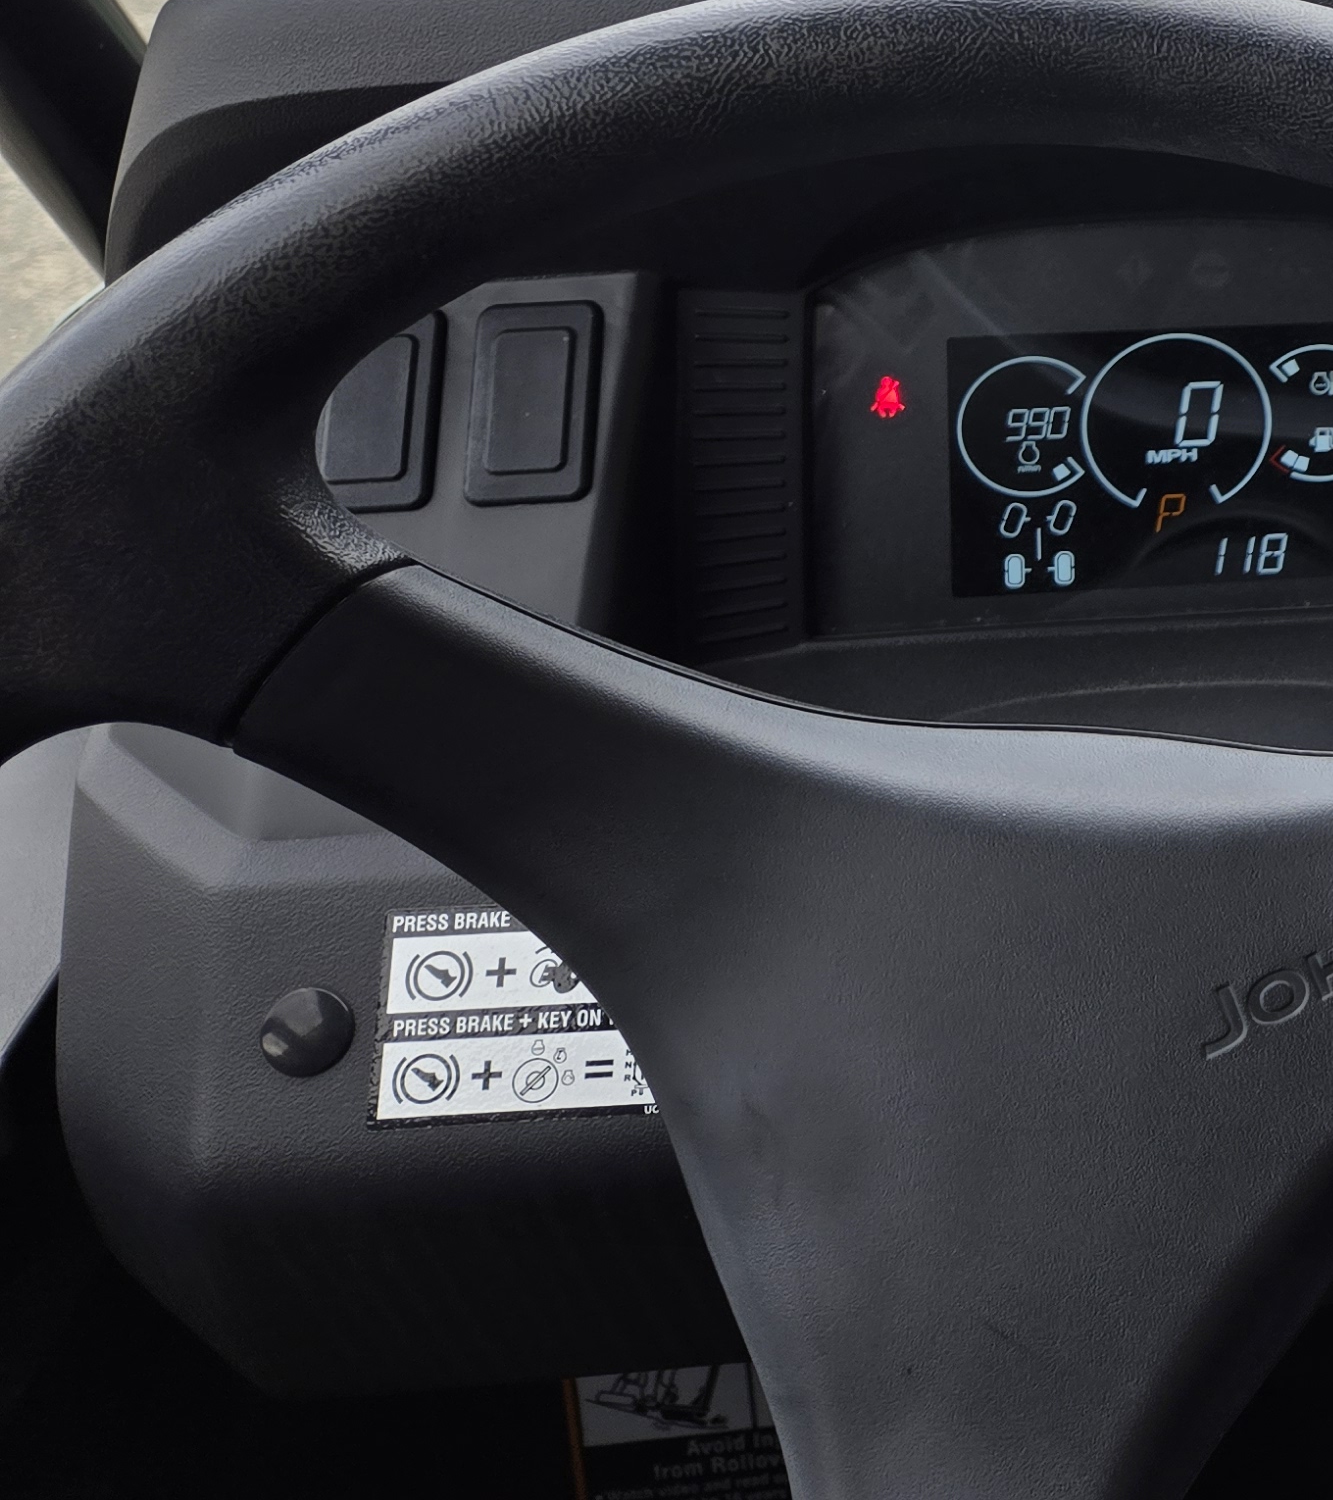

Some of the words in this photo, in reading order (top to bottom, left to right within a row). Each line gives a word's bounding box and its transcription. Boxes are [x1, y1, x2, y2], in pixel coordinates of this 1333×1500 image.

[1006, 406, 1071, 442] 990
[1175, 381, 1223, 447] 0
[1146, 448, 1198, 464] MPH
[1156, 494, 1186, 533] P
[1215, 533, 1288, 576] 118
[392, 913, 448, 933] PRESS
[454, 911, 511, 930] BRAKE
[393, 1017, 450, 1037] PRESS
[455, 1013, 514, 1033] BRAKE
[538, 1009, 571, 1029] KEY
[577, 1008, 601, 1027] ON
[644, 1105, 660, 1114] UC
[710, 1452, 785, 1473] Rollov
